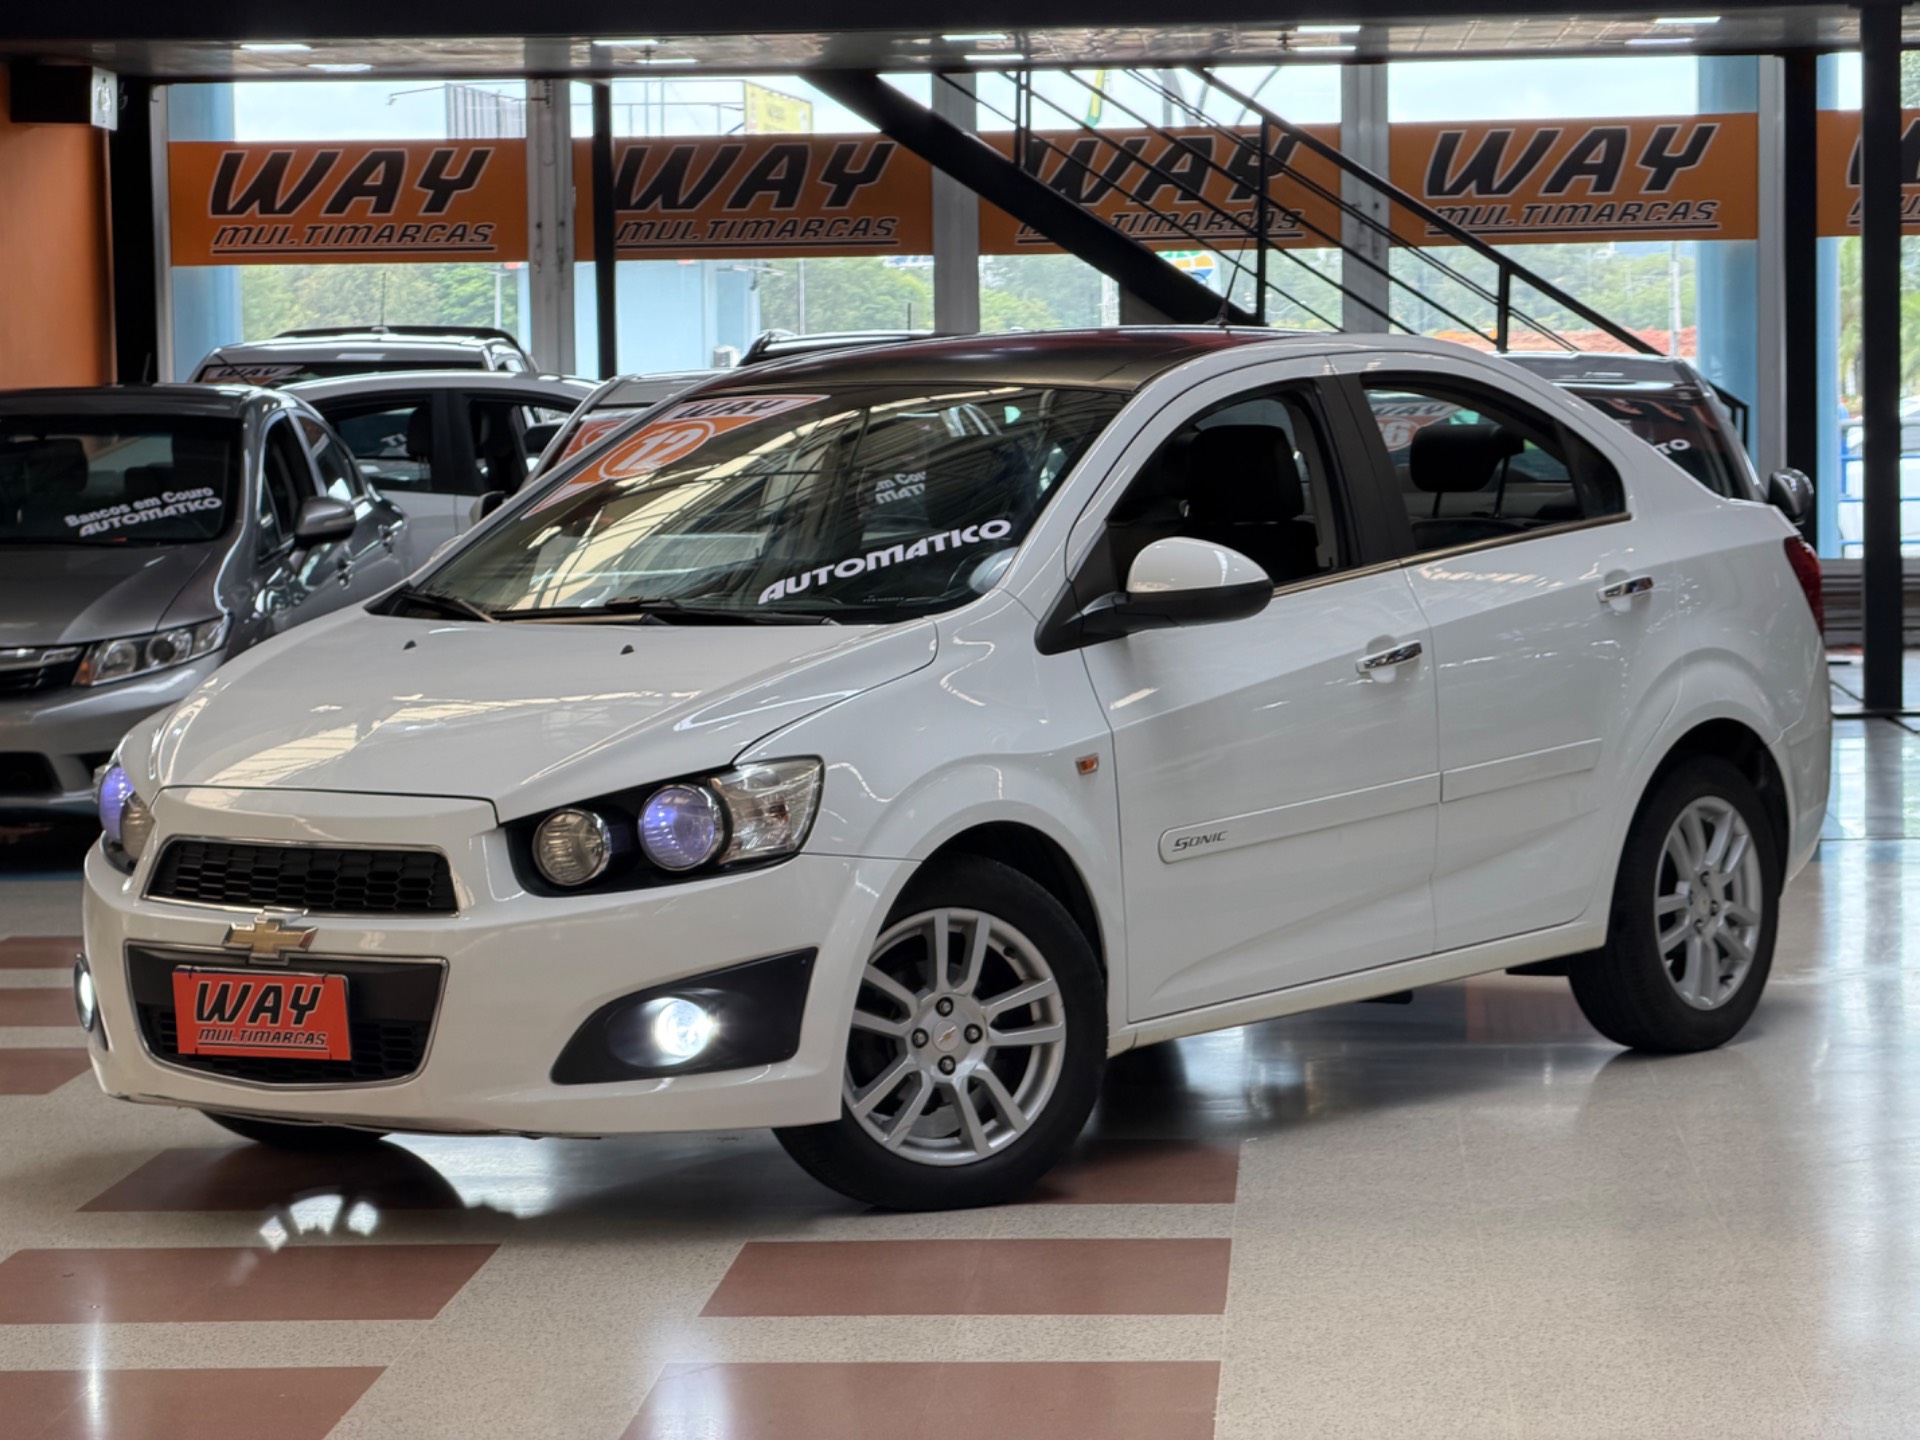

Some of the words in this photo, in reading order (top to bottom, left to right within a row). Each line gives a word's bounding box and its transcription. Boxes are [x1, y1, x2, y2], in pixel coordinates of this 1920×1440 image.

[615, 141, 899, 212] WAY
[1424, 123, 1721, 200] WAY
[208, 148, 496, 217] WAY
[616, 217, 899, 242] MULTIMARCAS
[1427, 201, 1720, 227] MULTIMARCAS
[211, 223, 496, 247] MULTIMARCAS
[671, 400, 788, 419] WAY
[612, 428, 705, 472] 12
[64, 504, 131, 527] Bancos
[133, 497, 161, 510] em
[162, 487, 214, 503] Couro
[79, 497, 222, 537] AUTOMATICO
[757, 519, 1012, 606] AUTOMATICO
[1171, 830, 1228, 852] SONIC
[194, 981, 323, 1026] WAY
[198, 1028, 327, 1046] MULTIMARCAS
